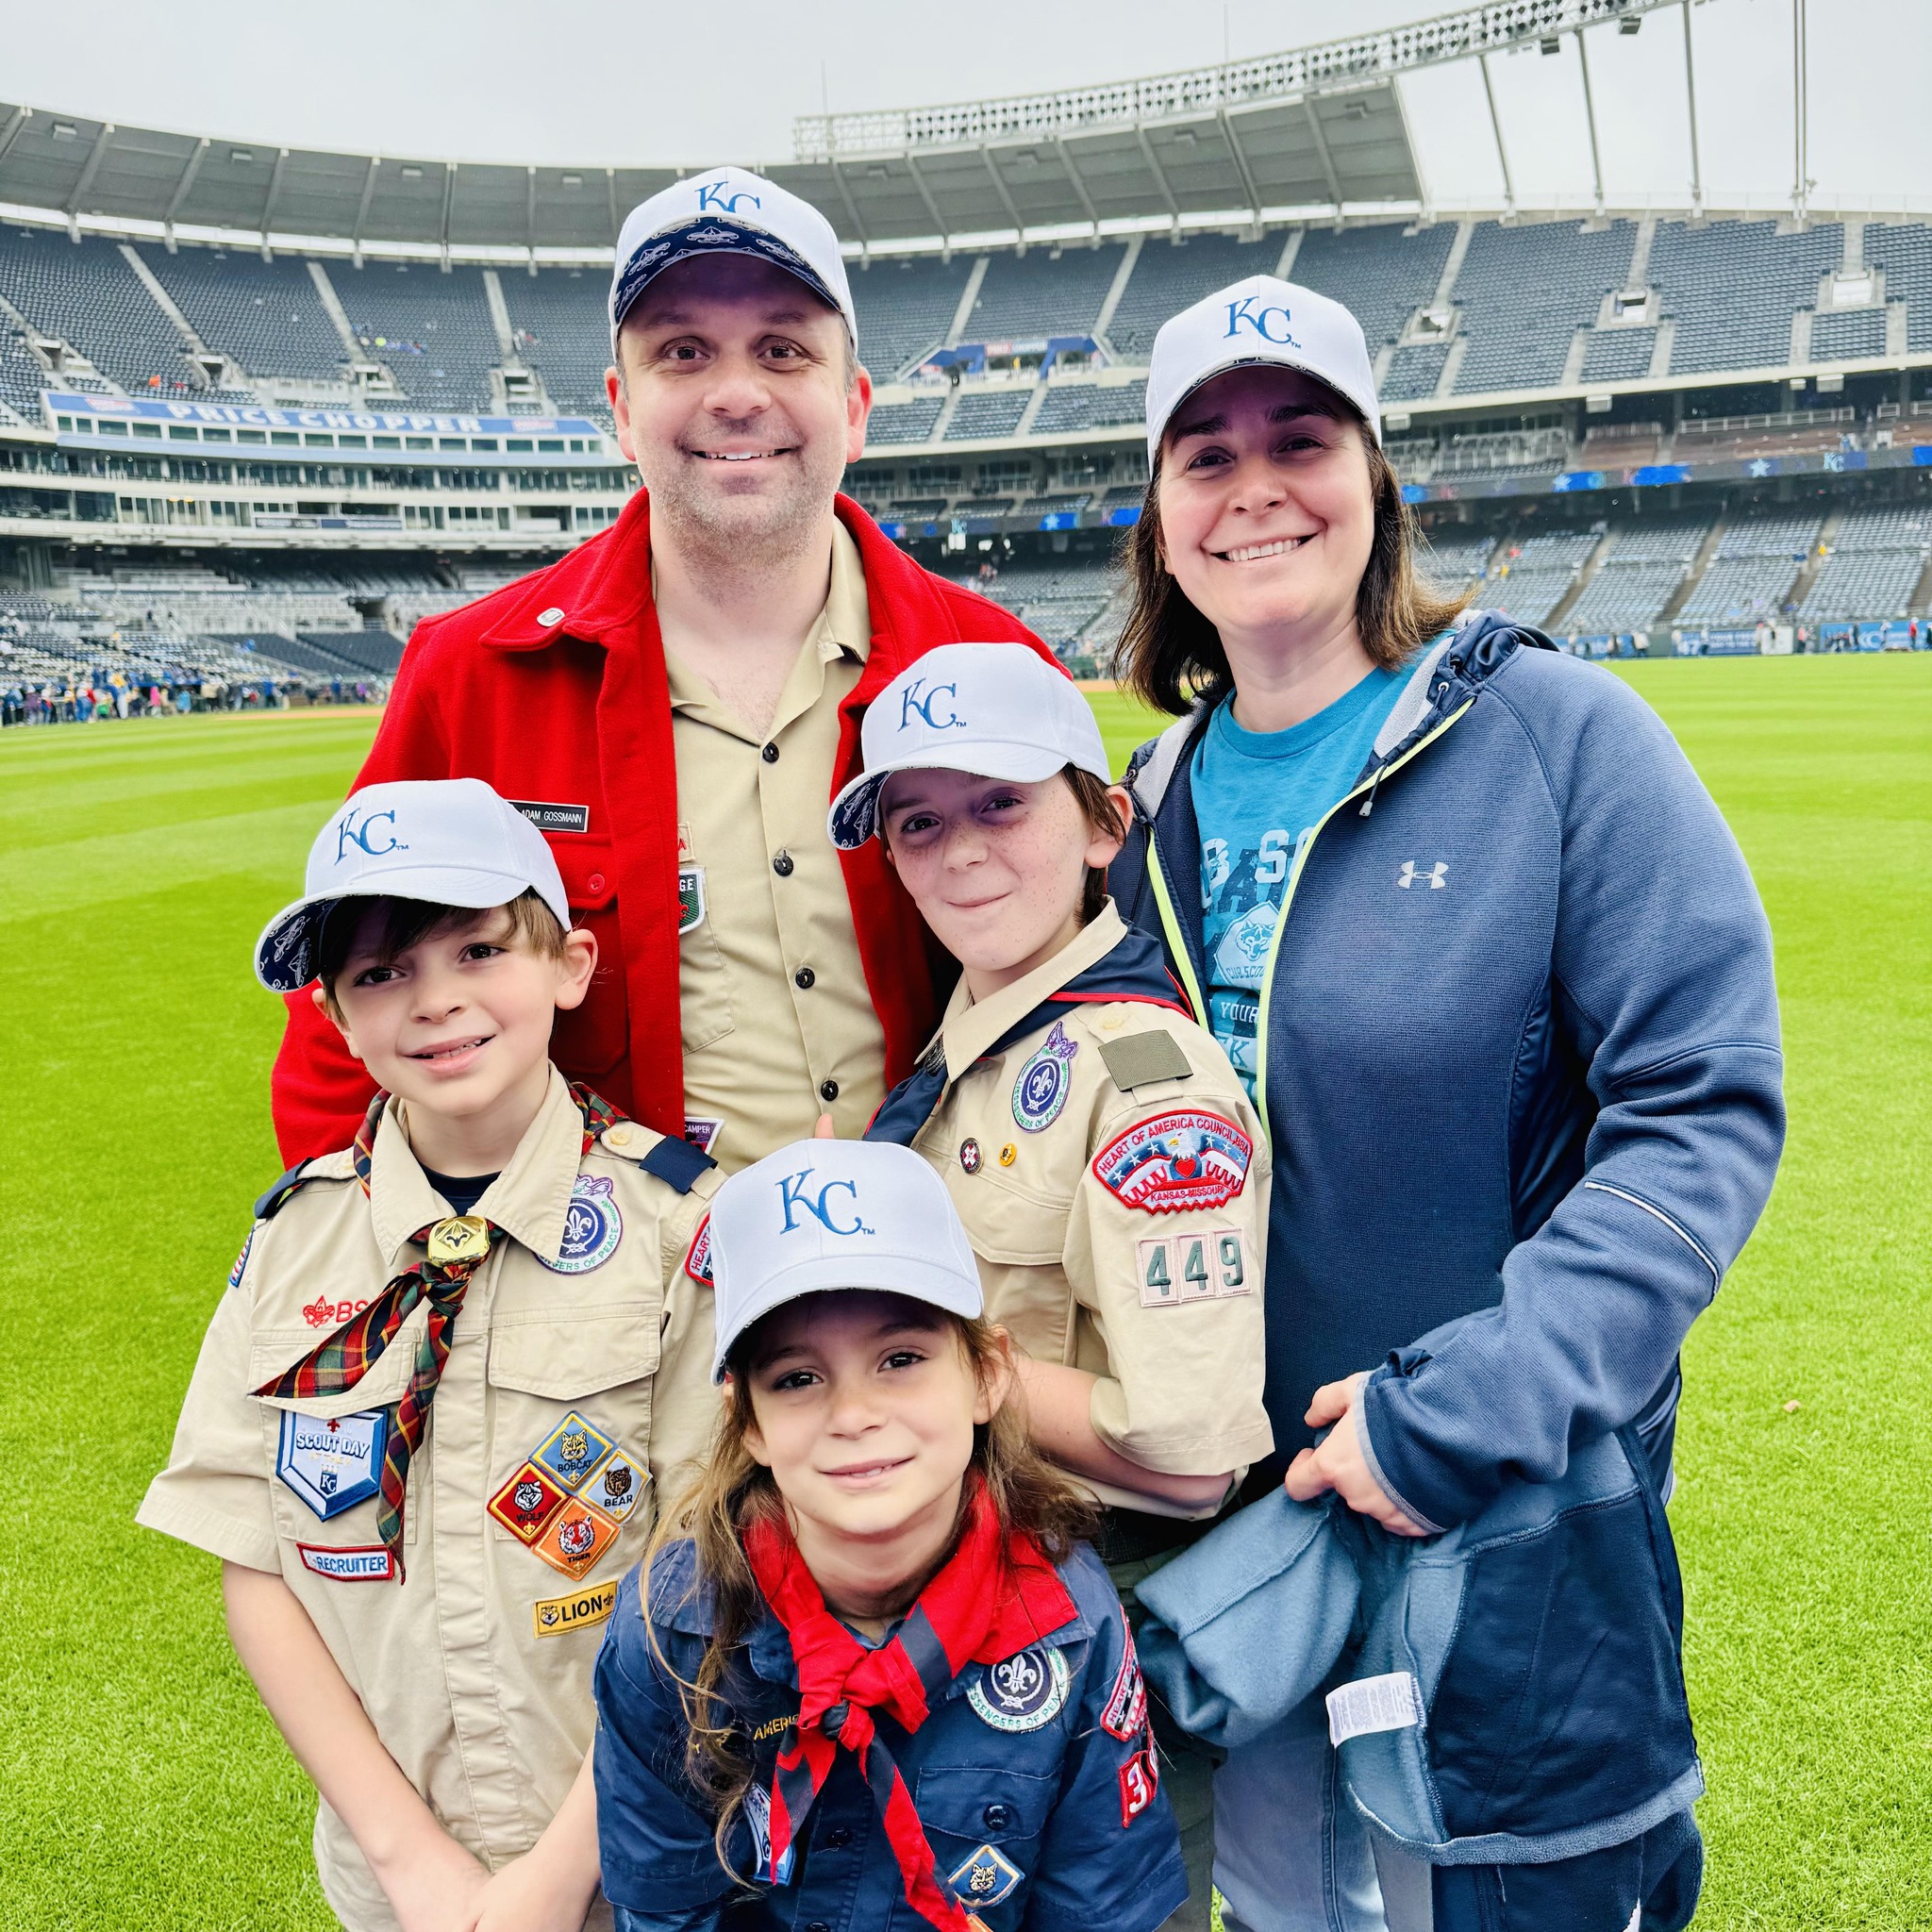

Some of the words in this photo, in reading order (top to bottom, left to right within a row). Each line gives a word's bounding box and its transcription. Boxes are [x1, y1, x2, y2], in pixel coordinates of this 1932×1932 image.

[1224, 295, 1291, 343] KC
[167, 404, 290, 425] PRICE
[298, 410, 482, 433] CHOPPER
[897, 677, 957, 732] KC
[521, 809, 541, 821] ADAM
[543, 811, 582, 824] GOSSMANN
[334, 808, 396, 866] KC
[1099, 1141, 1130, 1174] HEART
[1132, 1131, 1145, 1146] OF
[1147, 1118, 1194, 1139] AMERICA
[774, 1168, 862, 1235] KC
[583, 1256, 597, 1268] OF
[598, 1226, 619, 1259] PEACE
[691, 1232, 711, 1271] HEART
[1147, 1236, 1243, 1296] 449
[296, 1433, 340, 1453] SCOUT
[341, 1438, 371, 1459] DAY
[558, 1458, 593, 1473] BOBCAT
[322, 1474, 337, 1492] KC
[604, 1494, 633, 1507] BEAR
[516, 1511, 545, 1523] WOLF
[316, 1556, 388, 1573] RECRUITER
[567, 1552, 591, 1563] TIGER
[561, 1594, 603, 1623] LION
[1025, 1714, 1040, 1726] OF
